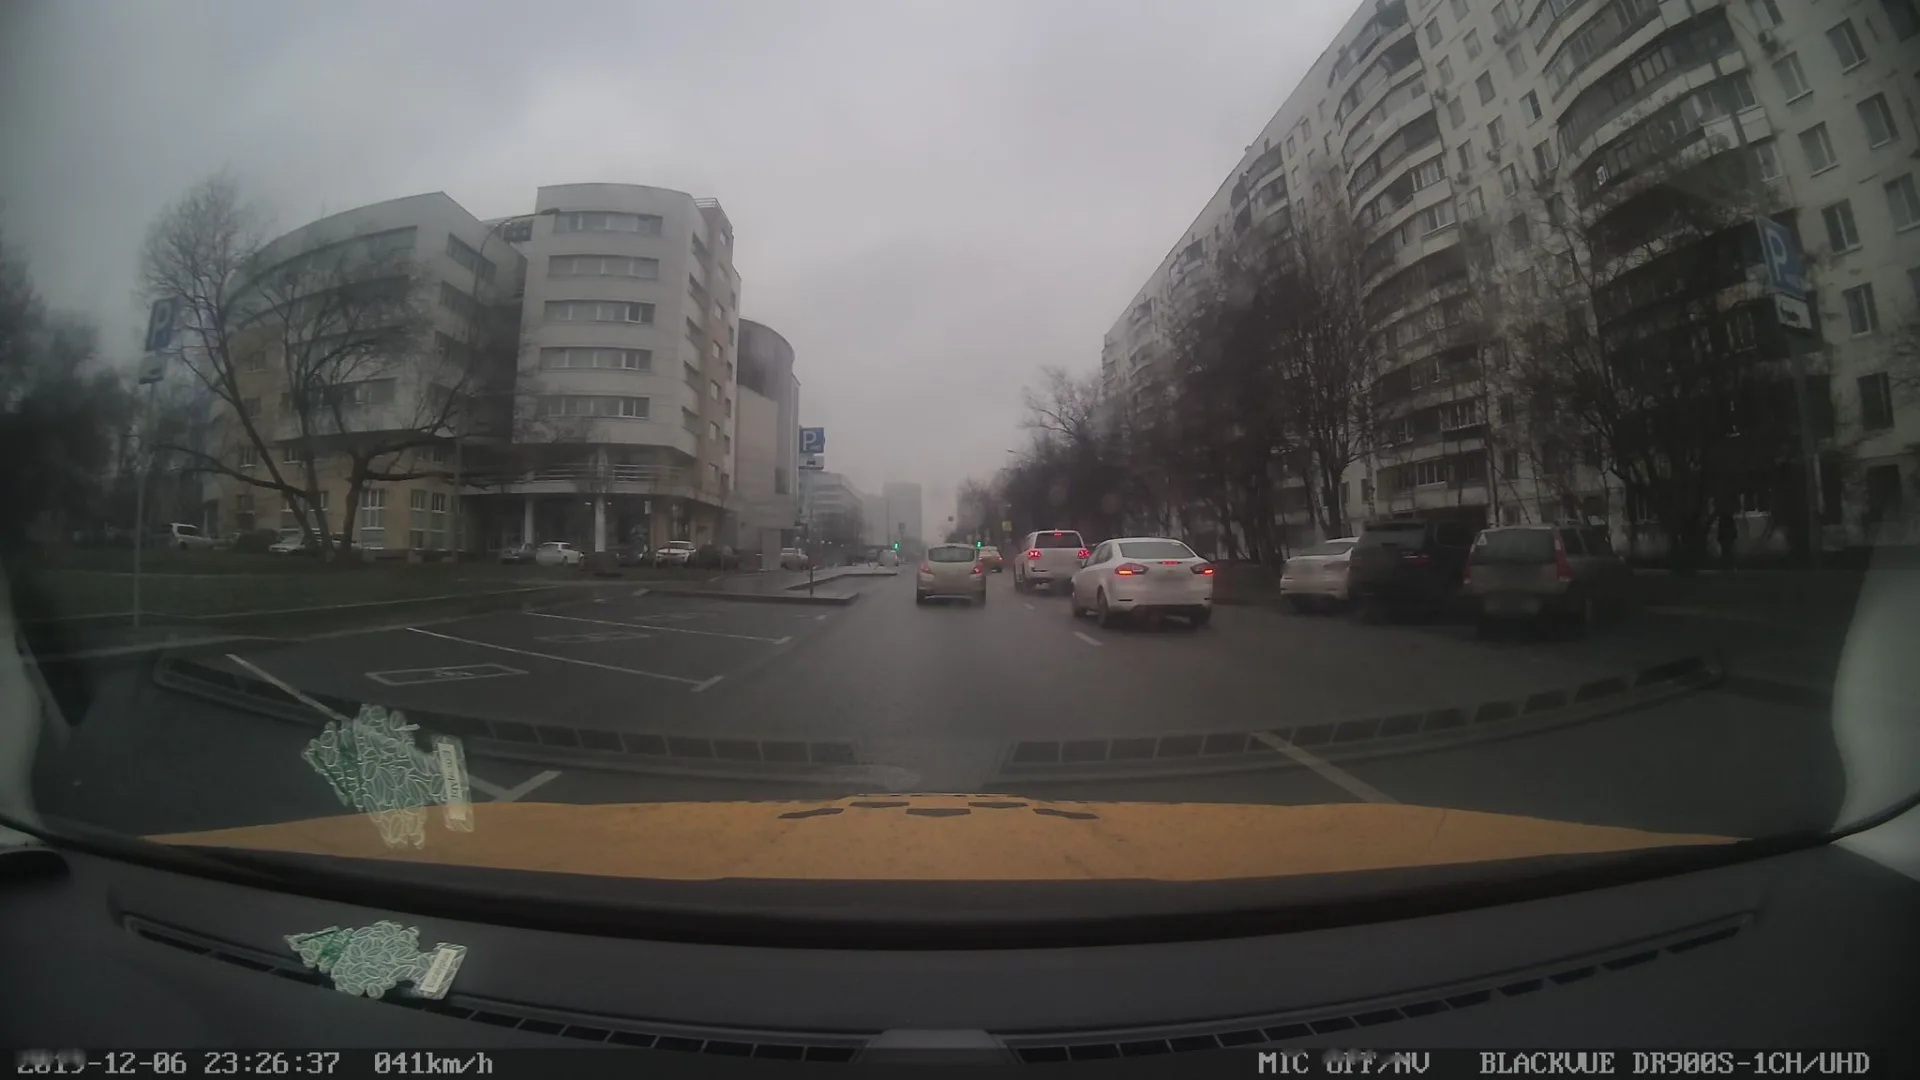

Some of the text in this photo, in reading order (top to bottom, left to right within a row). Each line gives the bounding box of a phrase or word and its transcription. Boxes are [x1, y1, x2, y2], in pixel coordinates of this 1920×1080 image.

[1763, 224, 1787, 282] P
[151, 301, 172, 346] P
[803, 430, 817, 450] P
